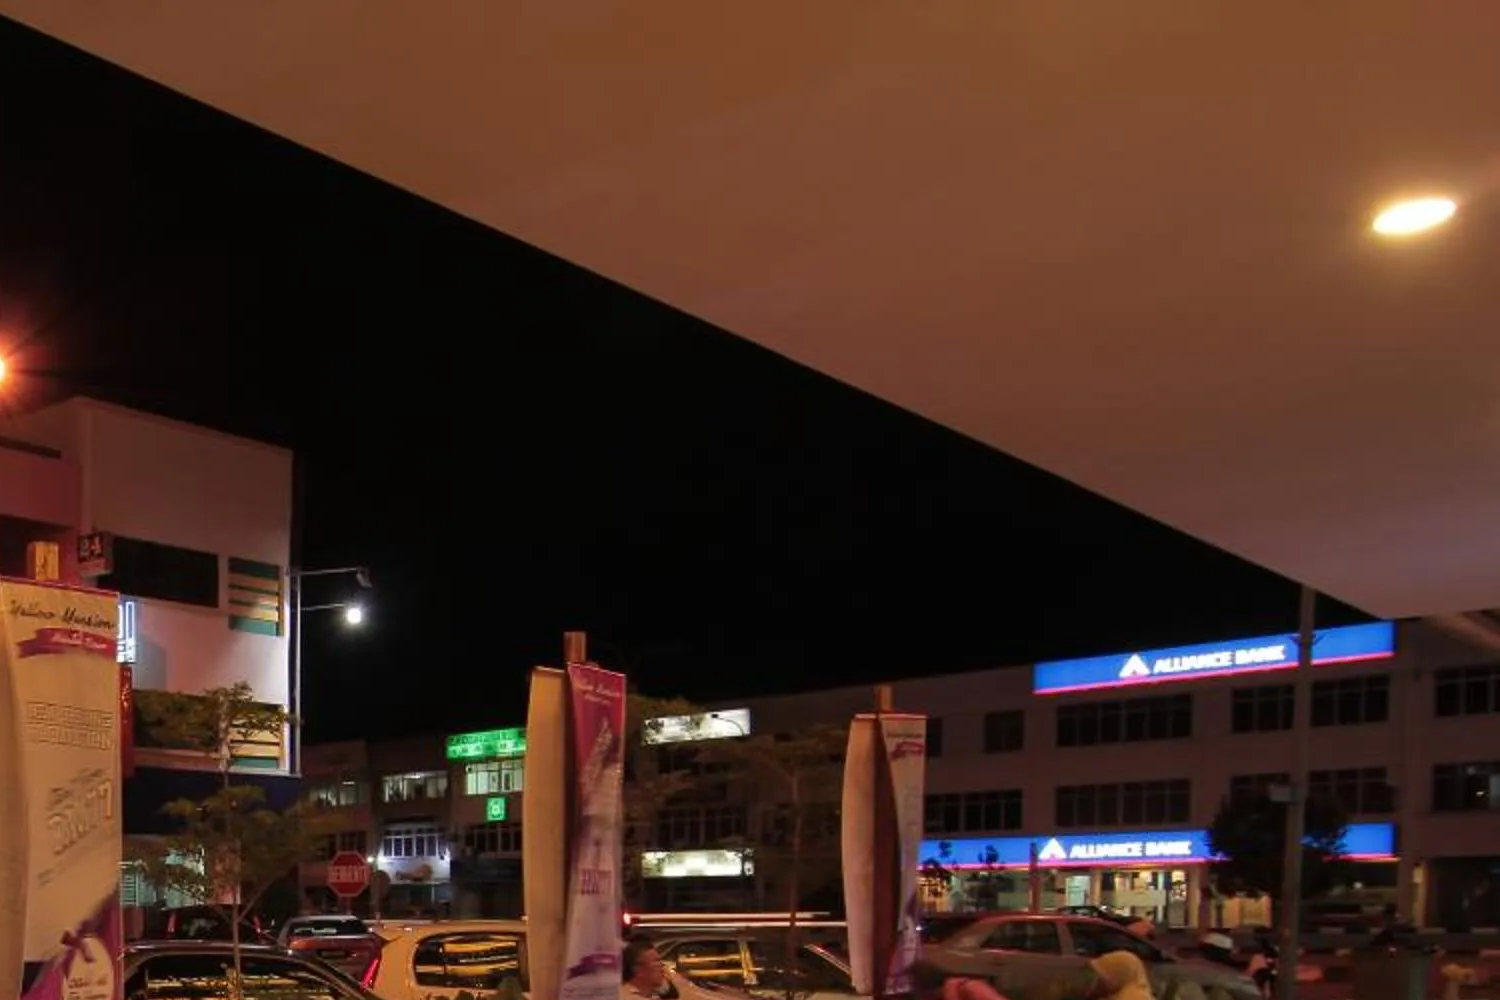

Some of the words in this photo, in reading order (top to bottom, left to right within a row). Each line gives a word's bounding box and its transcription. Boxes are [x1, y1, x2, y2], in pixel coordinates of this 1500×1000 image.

[1153, 651, 1234, 674] ALLIANCE
[1235, 645, 1286, 664] BANK
[1069, 842, 1143, 859] ALLIANCE
[1145, 840, 1191, 856] BANK
